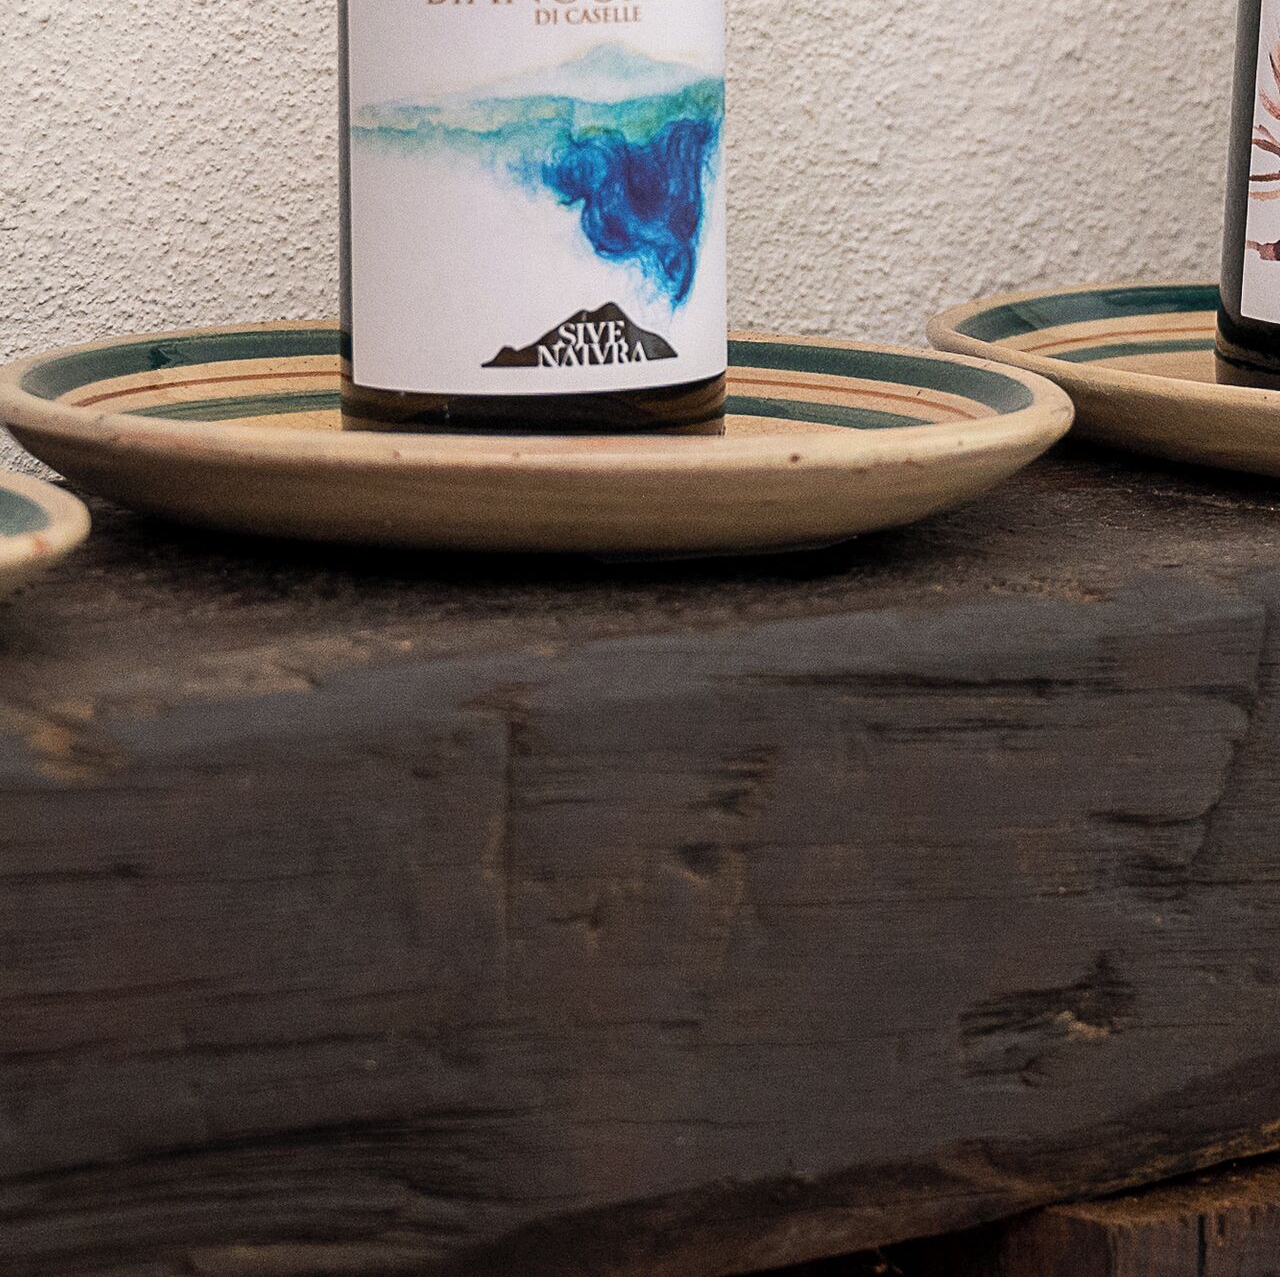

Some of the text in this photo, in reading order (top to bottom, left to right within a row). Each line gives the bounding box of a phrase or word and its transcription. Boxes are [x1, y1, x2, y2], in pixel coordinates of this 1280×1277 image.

[535, 6, 641, 25] DI CASELLE
[557, 321, 625, 347] SIVE
